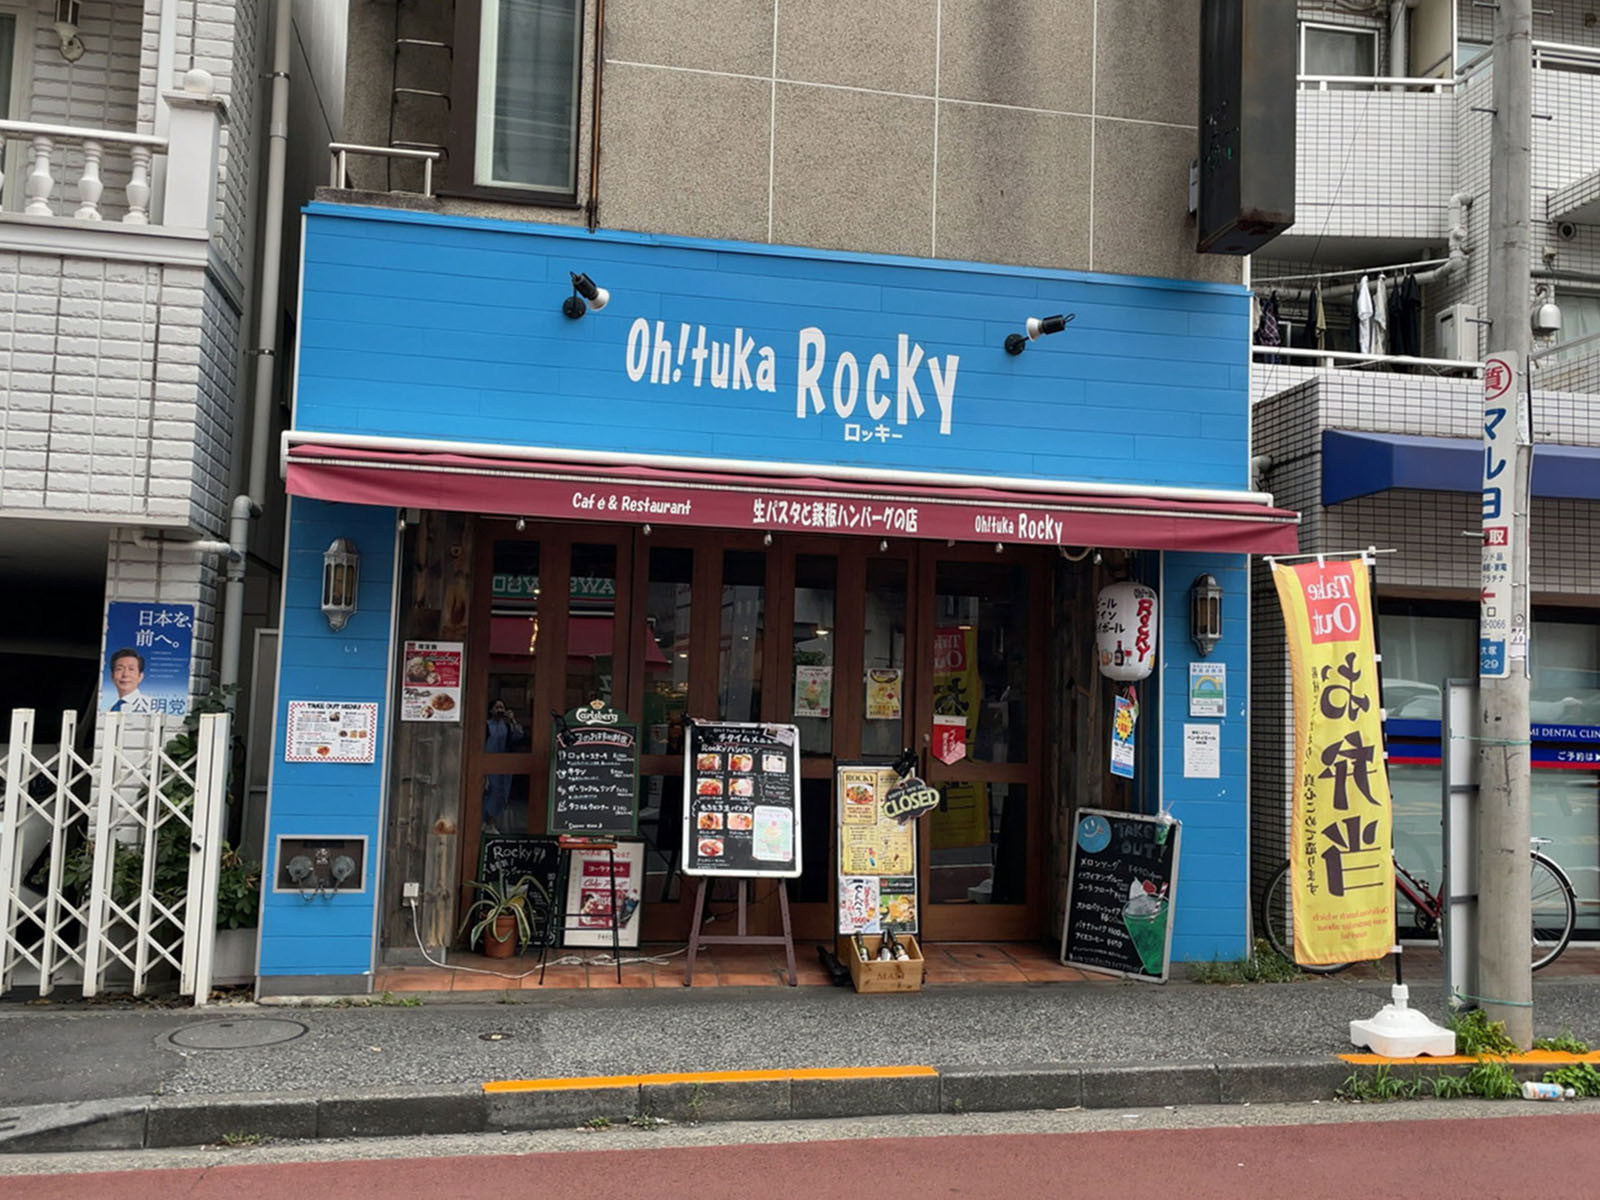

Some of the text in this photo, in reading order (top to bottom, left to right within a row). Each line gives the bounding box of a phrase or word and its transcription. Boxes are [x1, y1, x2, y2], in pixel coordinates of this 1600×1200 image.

[796, 326, 960, 436] Rocky
[844, 423, 903, 443] ロッキー
[608, 495, 619, 511] &
[620, 494, 692, 516] Restaurant
[752, 497, 919, 534] 生パスタと鉄板ハンバーグの店
[139, 609, 193, 629] 日本を、
[135, 628, 180, 648] 前へ。
[131, 698, 186, 715] 公明党
[575, 708, 618, 725] Carlsberg
[1541, 727, 1577, 738] DENTAL
[1557, 750, 1593, 762] ご予約は
[883, 788, 940, 817] CLOSED
